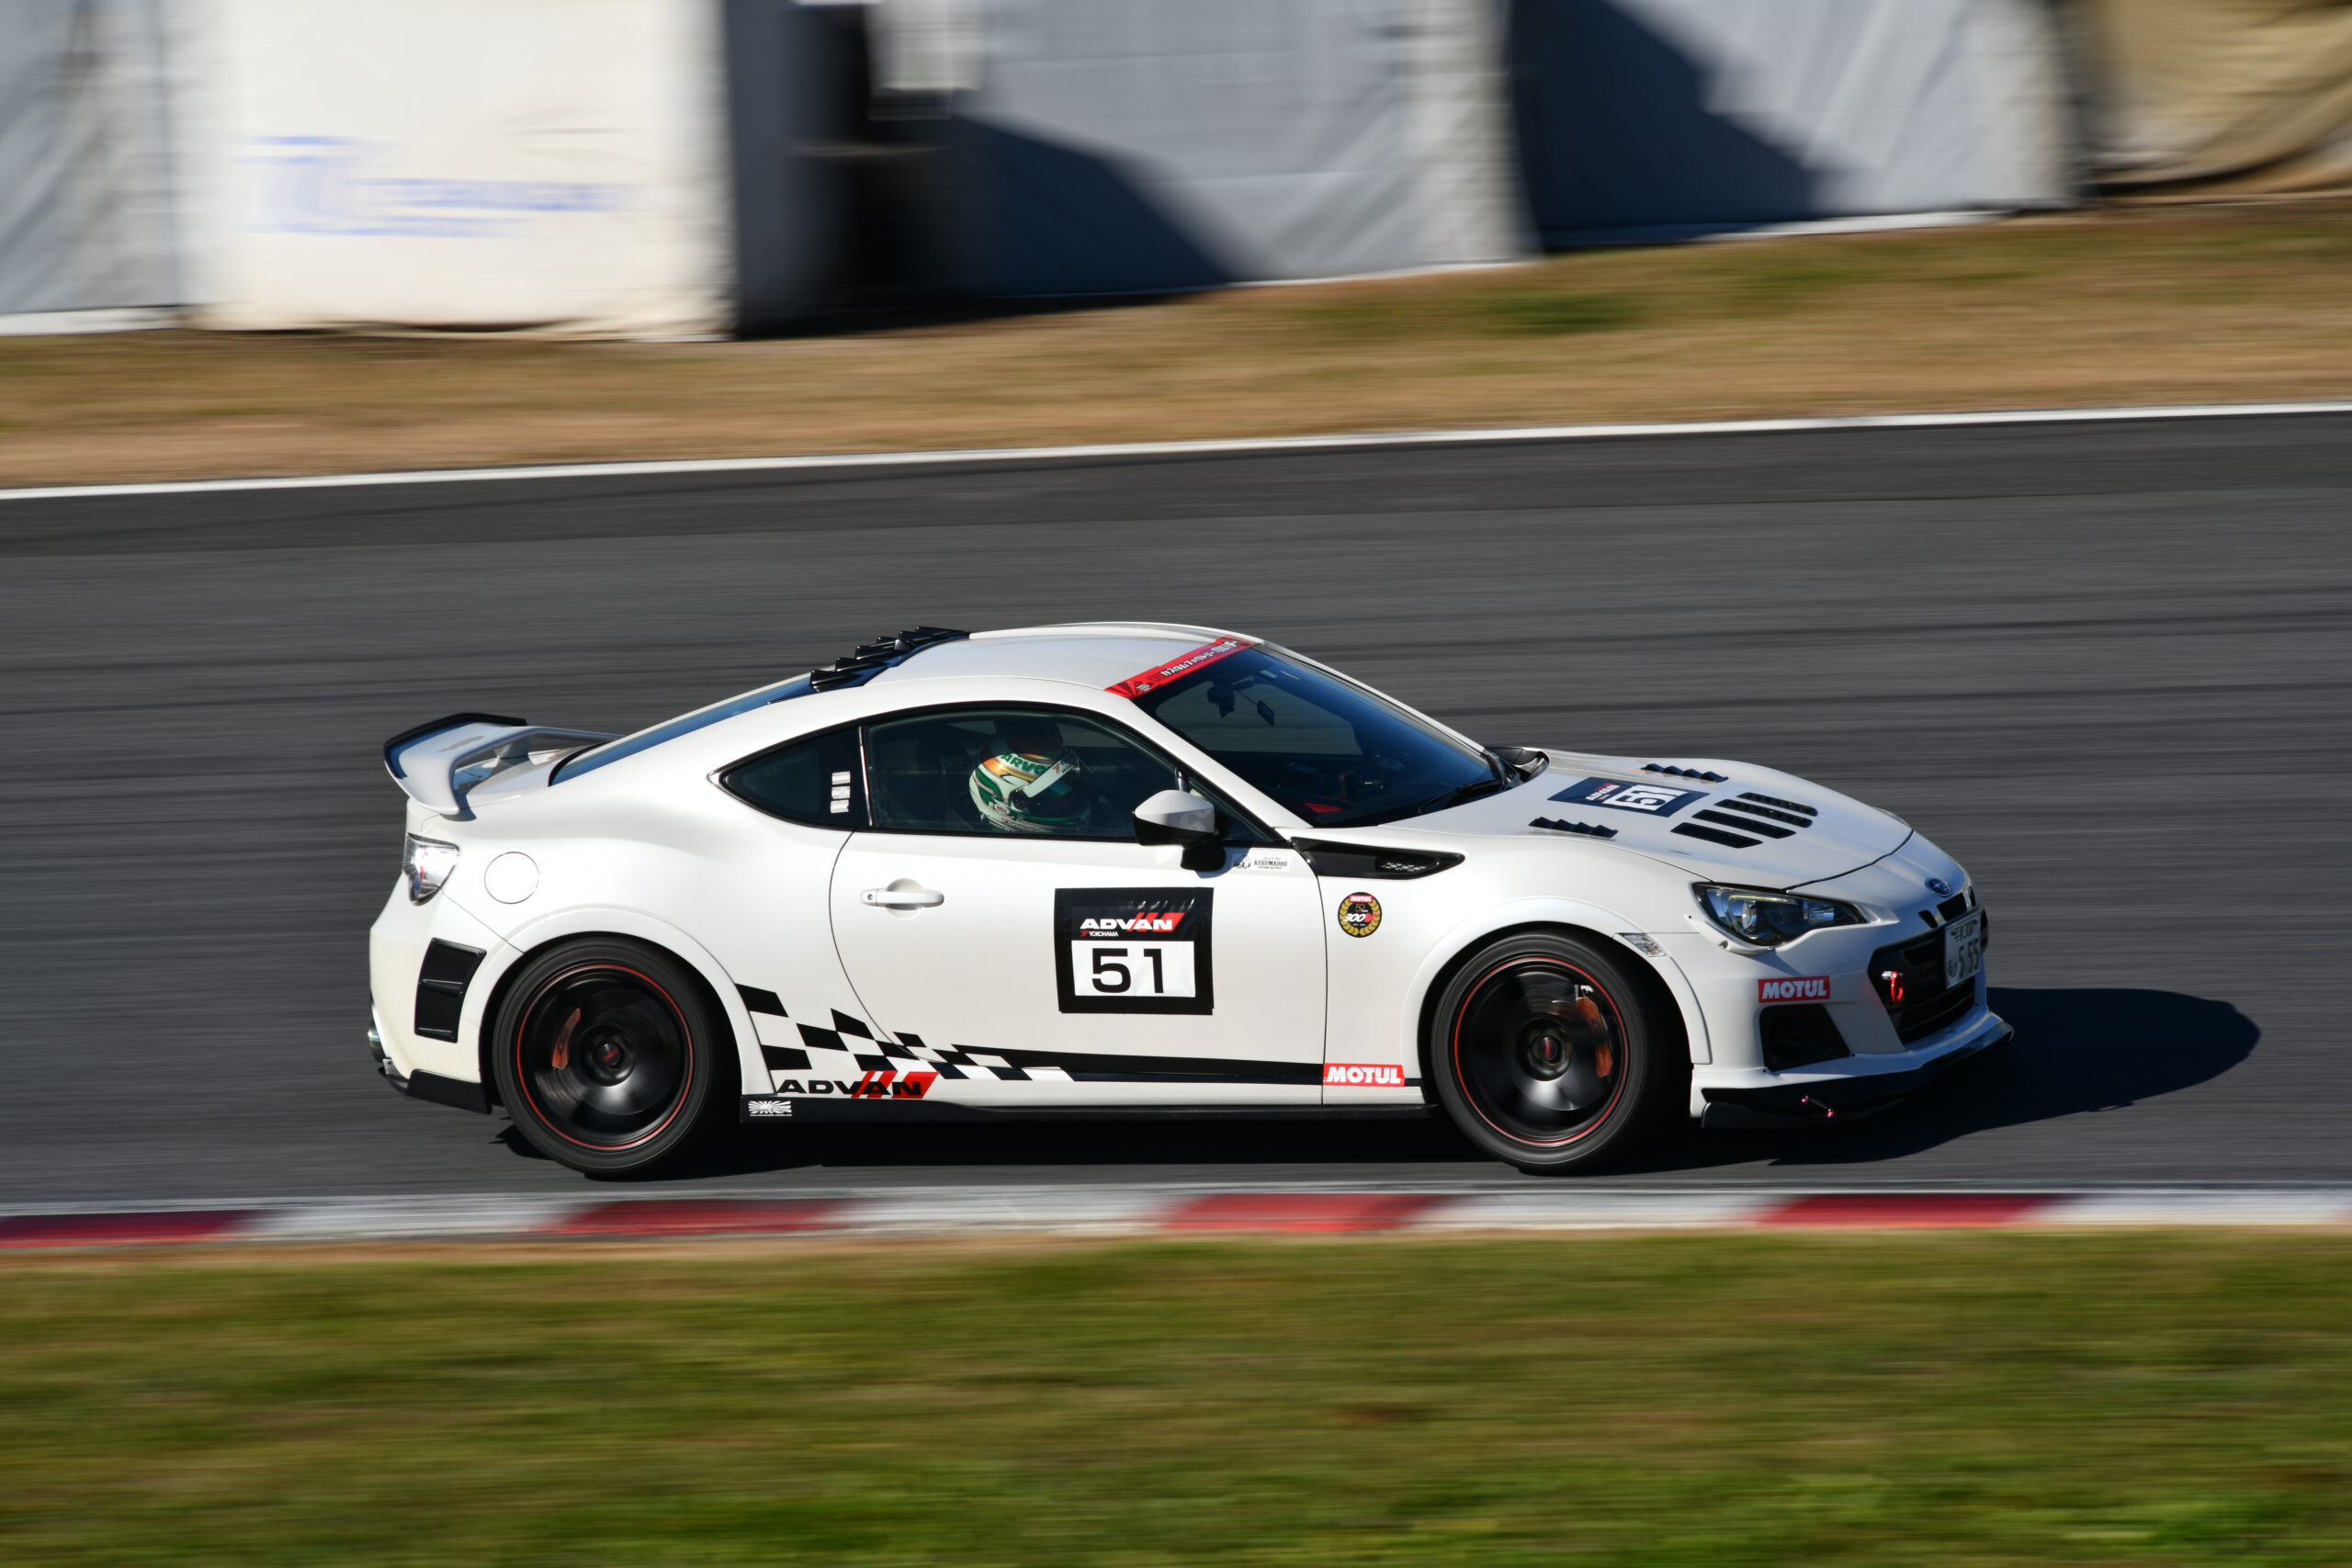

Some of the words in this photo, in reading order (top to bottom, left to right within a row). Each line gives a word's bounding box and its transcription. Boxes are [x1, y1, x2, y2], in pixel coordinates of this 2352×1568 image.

[1615, 790, 1679, 806] 51
[1080, 919, 1173, 930] ADVAN
[1343, 913, 1376, 923] 300V
[1091, 948, 1164, 994] 51
[1762, 980, 1826, 999] MOTUL
[1326, 1066, 1401, 1084] MOTUL
[776, 1079, 922, 1095] ADVAN
